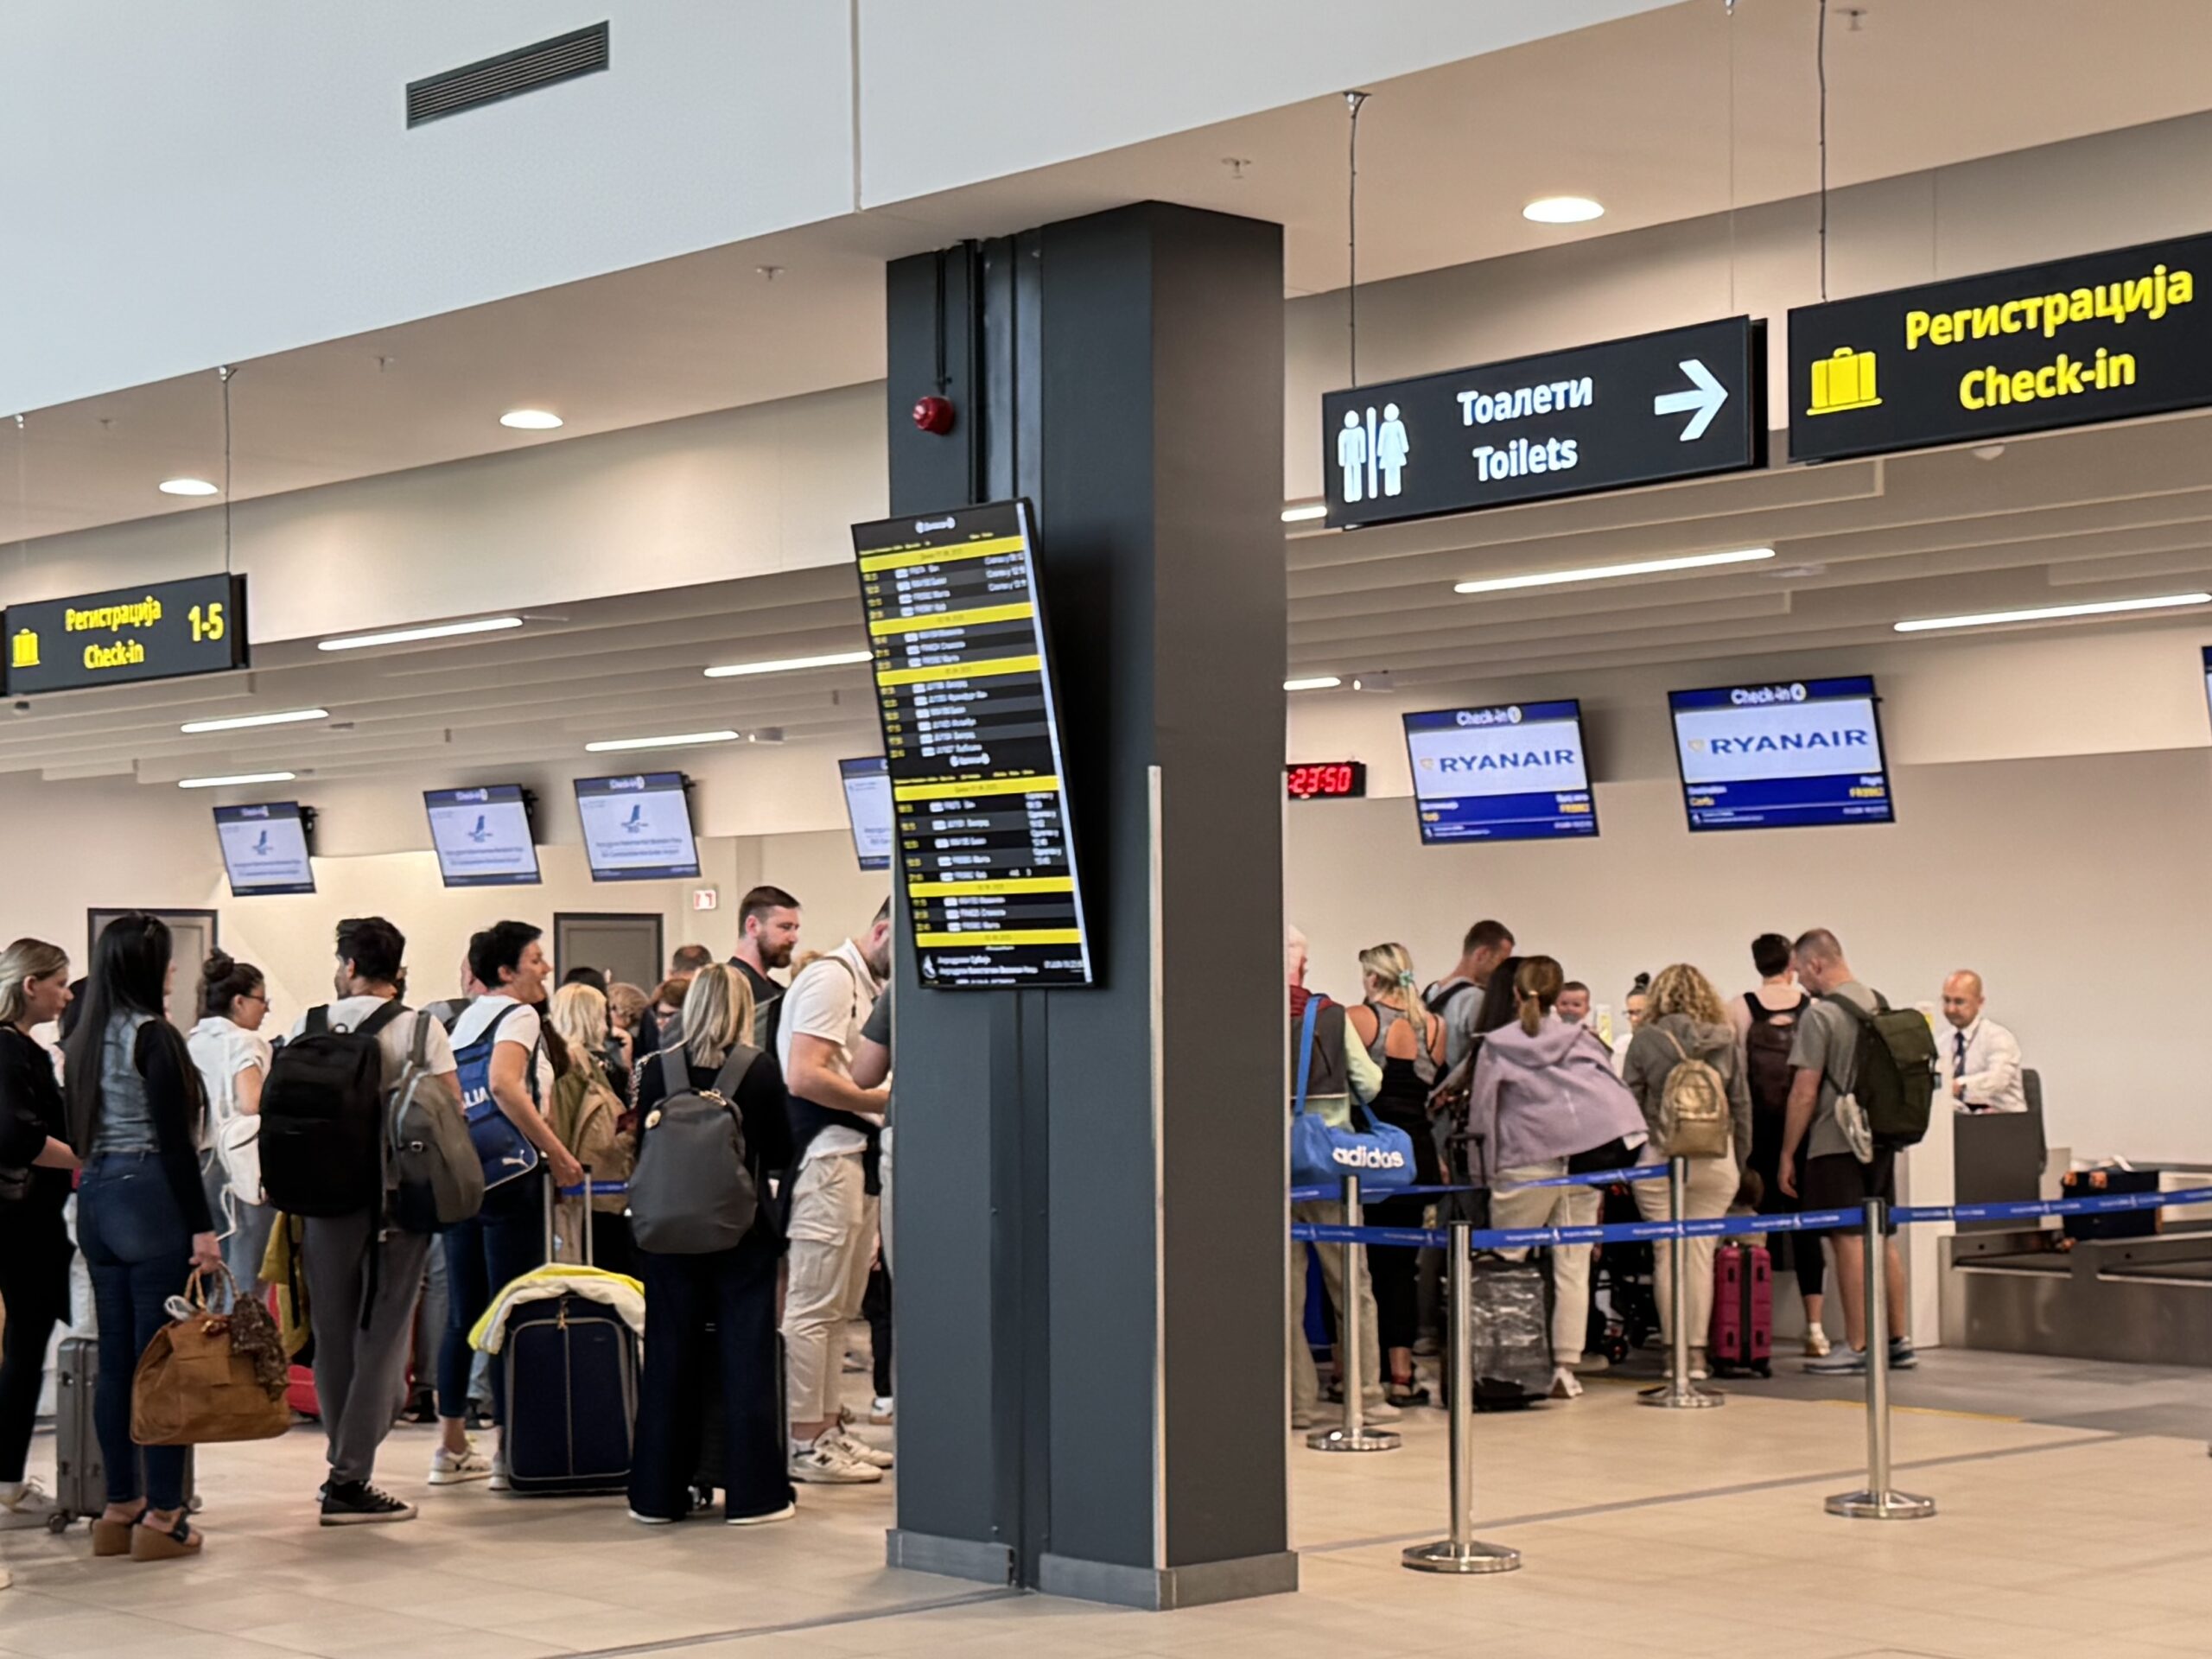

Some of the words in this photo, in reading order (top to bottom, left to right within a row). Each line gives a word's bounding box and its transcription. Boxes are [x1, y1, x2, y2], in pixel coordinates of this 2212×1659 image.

[1906, 264, 2193, 350] Регистрација
[1960, 347, 2136, 410] Check-in
[1457, 377, 1593, 426] Тоалети
[1471, 437, 1578, 483] Toilets
[65, 596, 162, 632] Регистрација
[188, 603, 225, 642] 1-5
[84, 639, 144, 669] Check-in
[1439, 749, 1574, 772] RYANAIR
[1710, 729, 1869, 755] RYANAIR
[1332, 1145, 1405, 1168] adidas
